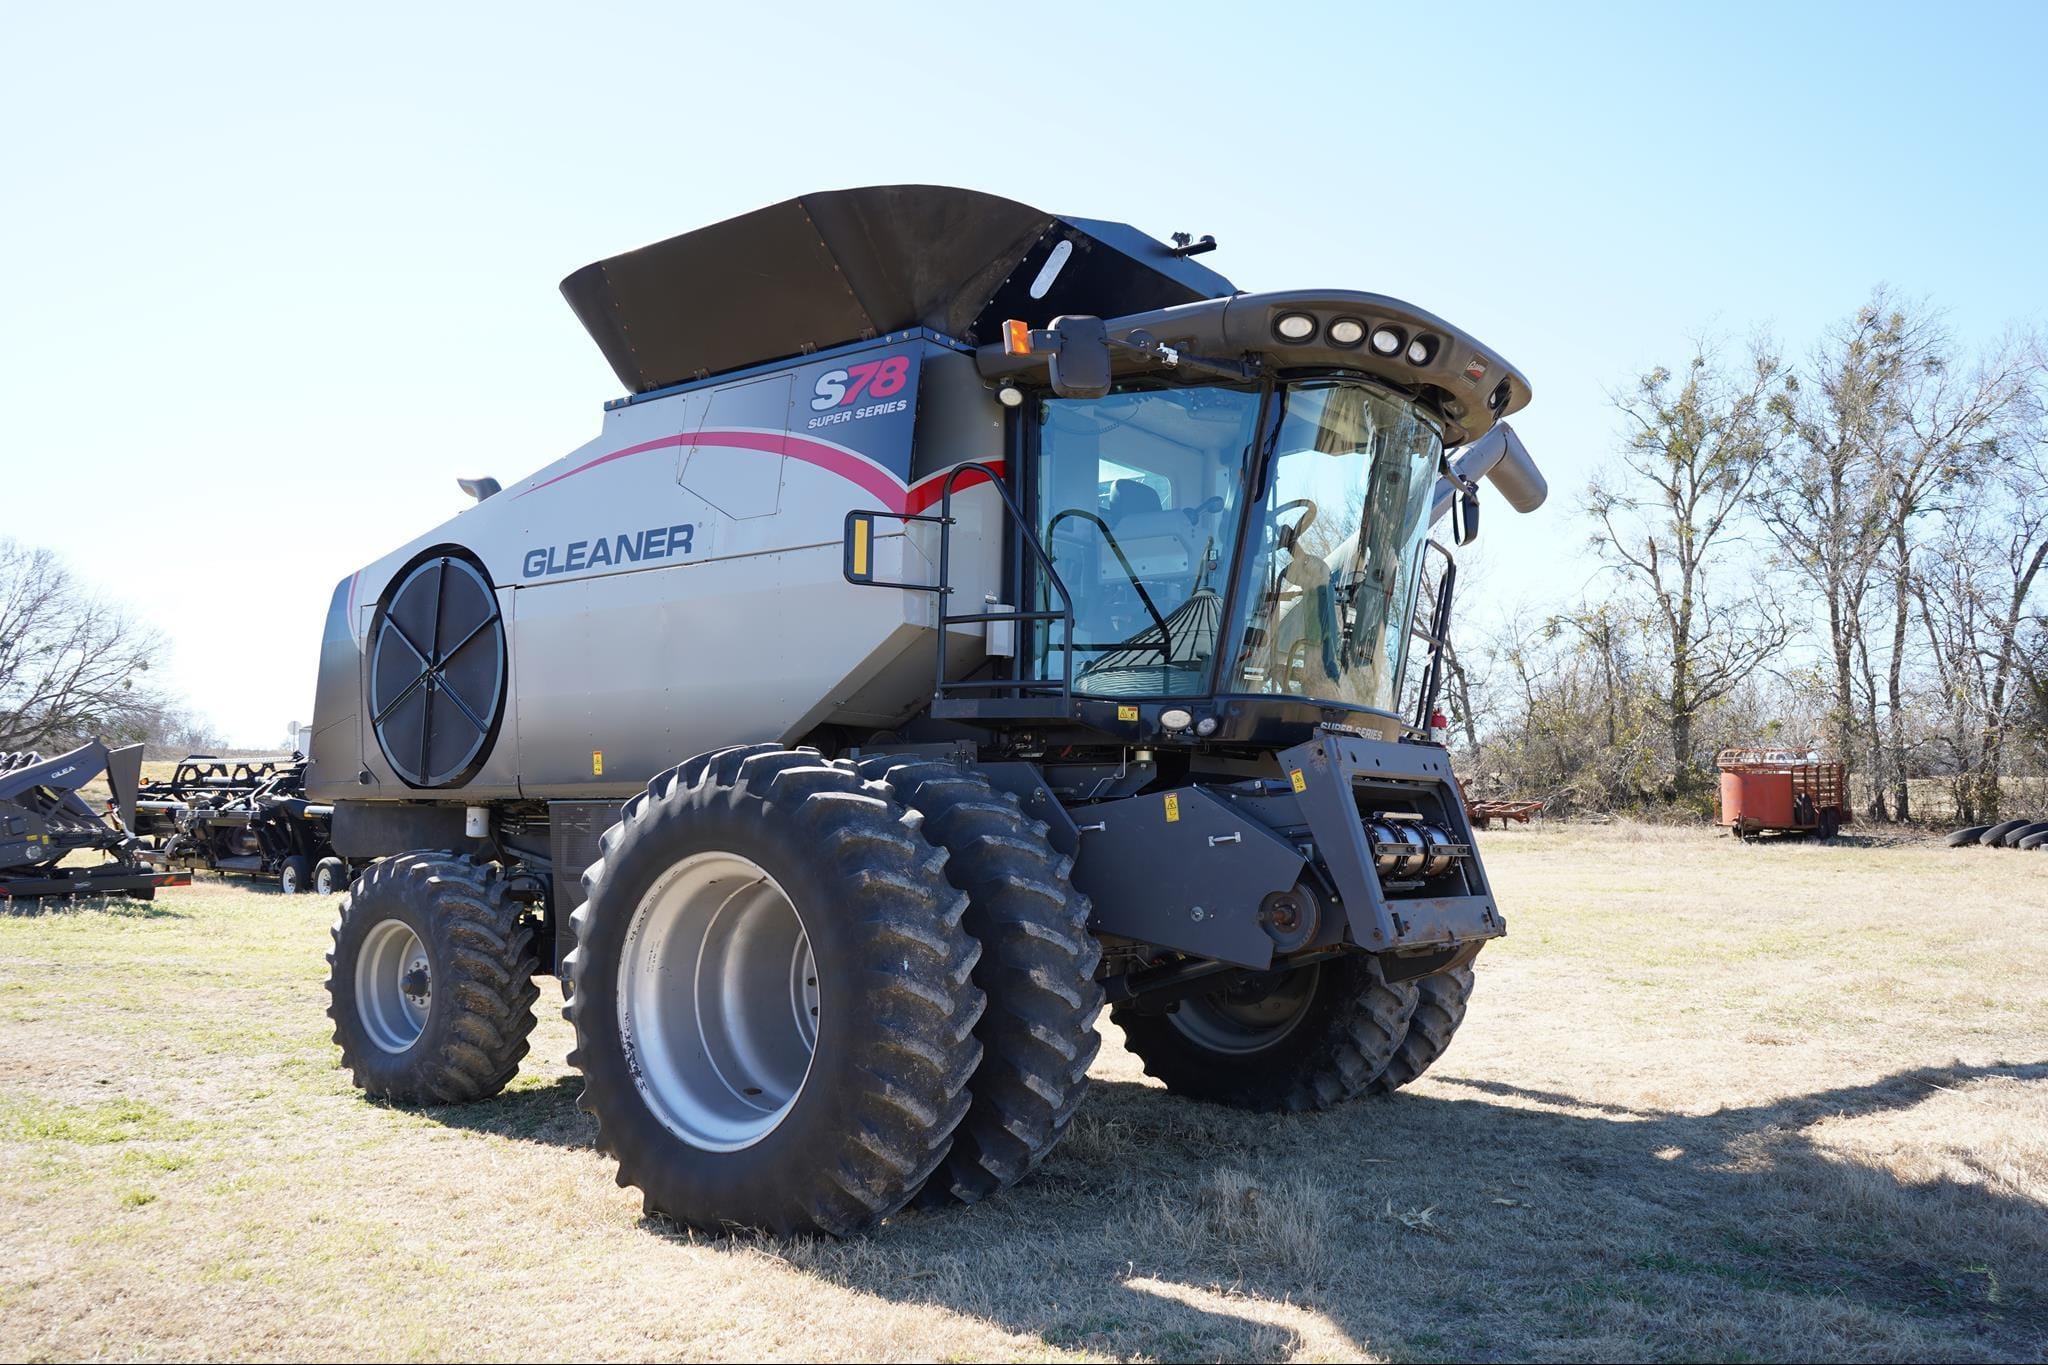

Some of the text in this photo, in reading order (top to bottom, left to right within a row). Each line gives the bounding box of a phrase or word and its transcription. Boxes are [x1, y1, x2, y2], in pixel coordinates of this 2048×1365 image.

[811, 355, 910, 410] S78
[807, 399, 907, 429] SUPER SERIES
[522, 523, 694, 578] GLEANER
[1355, 727, 1383, 740] SERIES
